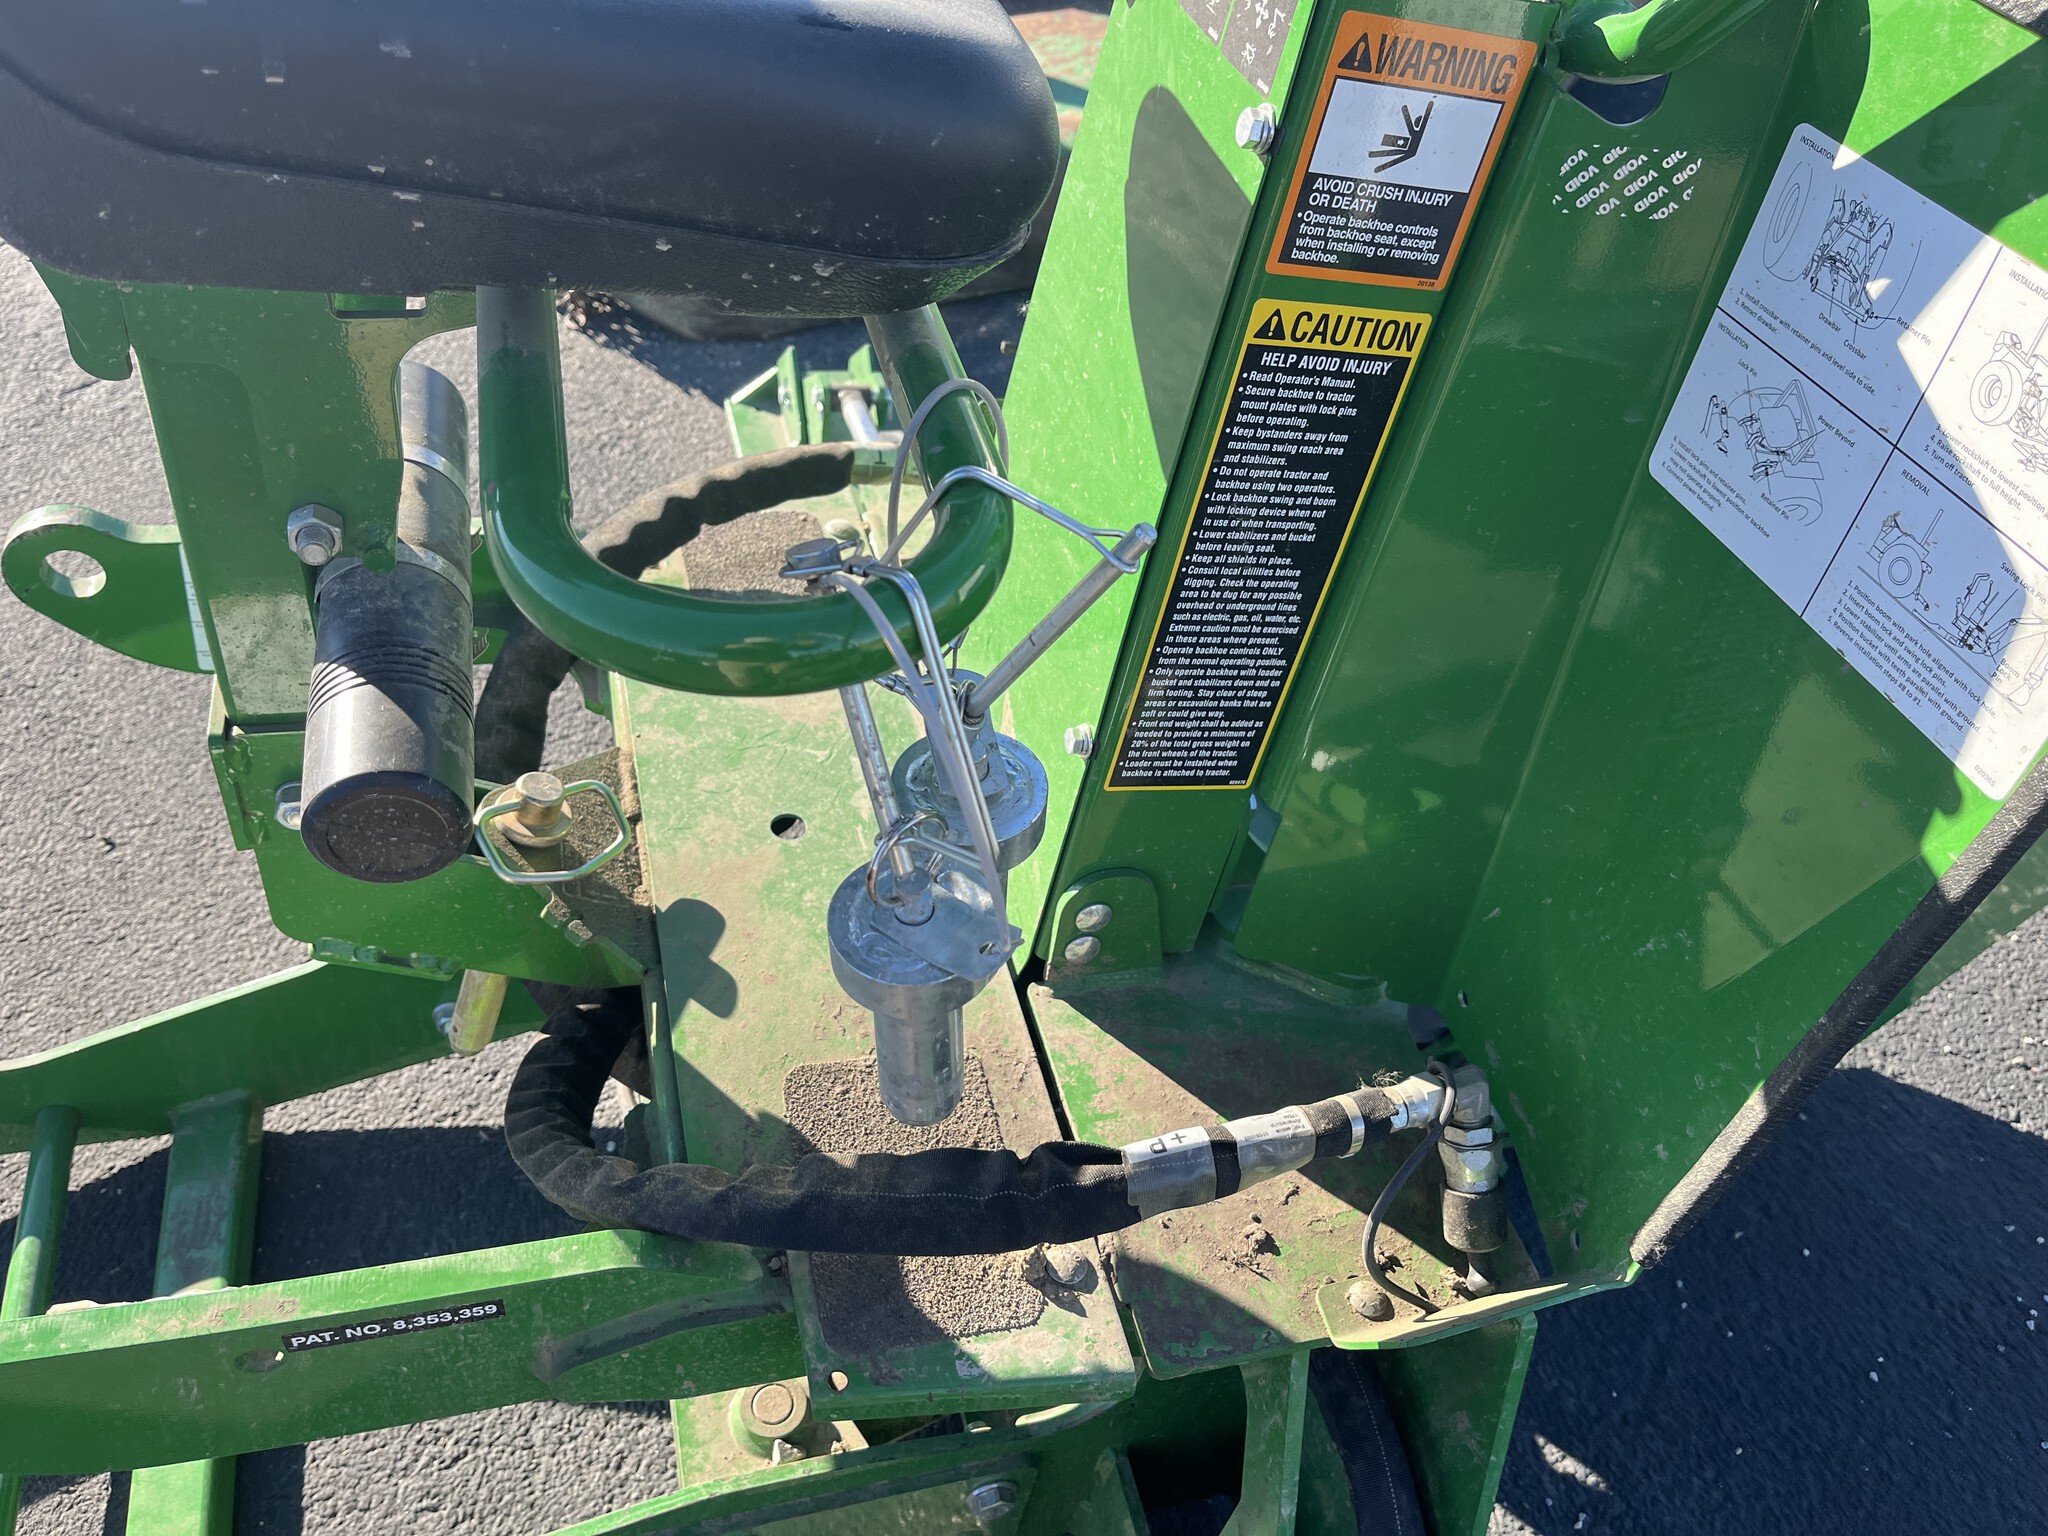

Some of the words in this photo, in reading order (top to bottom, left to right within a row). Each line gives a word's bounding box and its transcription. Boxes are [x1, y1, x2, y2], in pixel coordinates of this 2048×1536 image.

[1375, 34, 1518, 94] WARNING
[1602, 146, 1628, 165] OID
[1661, 150, 1688, 169] OID
[1799, 135, 1836, 162] INSTALLATION
[1612, 153, 1649, 181] VOID
[1564, 164, 1600, 193] VOID
[1623, 169, 1659, 197] VOID
[1308, 192, 1330, 207] OR
[1331, 195, 1377, 212] DEATH
[1312, 177, 1354, 194] AVOID
[1356, 182, 1404, 201] CRUSH
[1404, 189, 1453, 206] INJURY
[1575, 181, 1610, 209] VOID
[1633, 185, 1669, 213] VOID
[1303, 210, 1346, 226] Operate
[1347, 215, 1393, 231] backhoe
[1394, 224, 1438, 237] controls
[1298, 222, 1325, 236] from
[1325, 225, 1372, 242] backhoe
[1373, 234, 1398, 246] seat,
[1400, 237, 1436, 250] except
[1290, 247, 1339, 263] backhoe.
[1293, 236, 1325, 251] when
[1326, 238, 1375, 257] installing
[1376, 247, 1389, 256] or
[1389, 248, 1439, 264] removing
[2008, 268, 2048, 300] INSTALLATIO
[1740, 301, 1757, 318] Retract
[1756, 314, 1777, 334] drawbar.
[1818, 312, 1841, 332] Drawbar
[1290, 310, 1422, 352] CAUTION
[1717, 321, 1749, 350] INSTALLATION
[1895, 316, 1921, 337] Retainer
[1920, 333, 1931, 346] Pin
[1744, 291, 1760, 307] Install
[1758, 303, 1779, 321] crossbar
[1778, 318, 1790, 330] with
[1789, 327, 1811, 345] retainer
[1809, 342, 1821, 354] pins
[1821, 351, 1833, 362] and
[1831, 357, 1846, 372] level
[1844, 368, 1856, 381] side
[1855, 376, 1863, 385] to
[1862, 382, 1875, 396] side.
[1843, 339, 1867, 360] Crossbar
[1260, 351, 1297, 367] HELP
[1297, 354, 1340, 371] AVOID
[1341, 358, 1394, 375] INJURY
[1248, 370, 1274, 382] Read
[1274, 372, 1320, 386] Operator's
[1320, 375, 1356, 388] Manual.
[1244, 384, 1276, 396] Secure
[1276, 386, 1314, 399] backhoe
[1314, 390, 1325, 400] to
[1325, 390, 1355, 402] tractor
[1239, 400, 1269, 410] mount
[1268, 400, 1297, 412] plates
[1298, 403, 1317, 413] with
[1318, 403, 1338, 415] lock
[1336, 405, 1357, 417] pins
[1235, 412, 1264, 423] before
[1265, 416, 1309, 428] operating.
[1817, 414, 1835, 431] Power
[1833, 428, 1855, 448] Beyond
[1231, 425, 1254, 438] Keep
[1255, 427, 1303, 440] bystanders
[1303, 432, 1327, 443] away
[1327, 431, 1348, 442] from
[1227, 440, 1270, 451] maximum
[1271, 442, 1298, 454] swing
[1298, 444, 1323, 454] reach
[1323, 446, 1344, 455] area
[1222, 453, 1241, 463] and
[1240, 453, 1287, 465] stabilizers.
[1931, 448, 1944, 464] Turn
[1944, 461, 1955, 471] off
[1953, 467, 1975, 487] tractor
[1218, 465, 1232, 475] Do
[1232, 467, 1248, 476] not
[1248, 468, 1282, 478] operate
[1282, 469, 1312, 479] tractor
[1311, 471, 1329, 480] and
[1936, 438, 1953, 455] Raise
[1950, 452, 1981, 478] rockshaft
[1980, 474, 1988, 483] to
[1988, 479, 2001, 493] full
[1999, 487, 2021, 511] height.
[1940, 428, 1961, 446] Lower
[1960, 444, 1990, 469] rockshaft
[1989, 465, 1997, 475] to
[1996, 470, 2019, 492] lowest
[2017, 489, 2045, 513] position
[1214, 478, 1250, 490] backhoe
[1251, 480, 1276, 492] using
[1276, 481, 1293, 491] two
[1293, 483, 1335, 494] operators.
[1900, 468, 1929, 496] REMOVAL
[1210, 491, 1232, 501] Lock
[1232, 492, 1268, 504] backhoe
[1268, 494, 1294, 506] swing
[1295, 495, 1313, 505] and
[1312, 496, 1336, 506] boom
[1206, 504, 1227, 514] with
[1226, 504, 1257, 517] locking
[1258, 506, 1286, 516] device
[1287, 507, 1310, 517] when
[1311, 509, 1326, 518] not
[1202, 516, 1212, 526] in
[1212, 516, 1230, 527] use
[1229, 517, 1241, 527] or
[1239, 518, 1264, 529] when
[1264, 519, 1316, 531] transporting.
[1198, 529, 1226, 539] Lower
[1225, 530, 1270, 540] stabilizers
[1270, 532, 1288, 541] and
[1287, 531, 1316, 542] bucket
[1194, 541, 1222, 551] before
[1223, 542, 1254, 553] leaving
[1255, 543, 1275, 552] seat.
[2000, 562, 2019, 583] Swing
[2019, 578, 2036, 595] Lock
[2034, 590, 2046, 604] Pin
[1990, 671, 2002, 684] Pin
[1995, 664, 2011, 681] Lock
[1999, 657, 2019, 678] Boom
[1121, 769, 1153, 777] backhoe
[1153, 768, 1162, 776] is
[1162, 768, 1195, 776] attached
[1195, 768, 1204, 777] to
[1204, 768, 1230, 776] tractor.
[1124, 759, 1152, 767] Loader
[1152, 759, 1172, 767] must
[1172, 758, 1183, 767] be
[1183, 758, 1217, 766] installed
[1216, 758, 1238, 766] when
[291, 1331, 340, 1347] PAT.
[345, 1324, 387, 1338] NO.
[393, 1304, 498, 1330] 8,353,359
